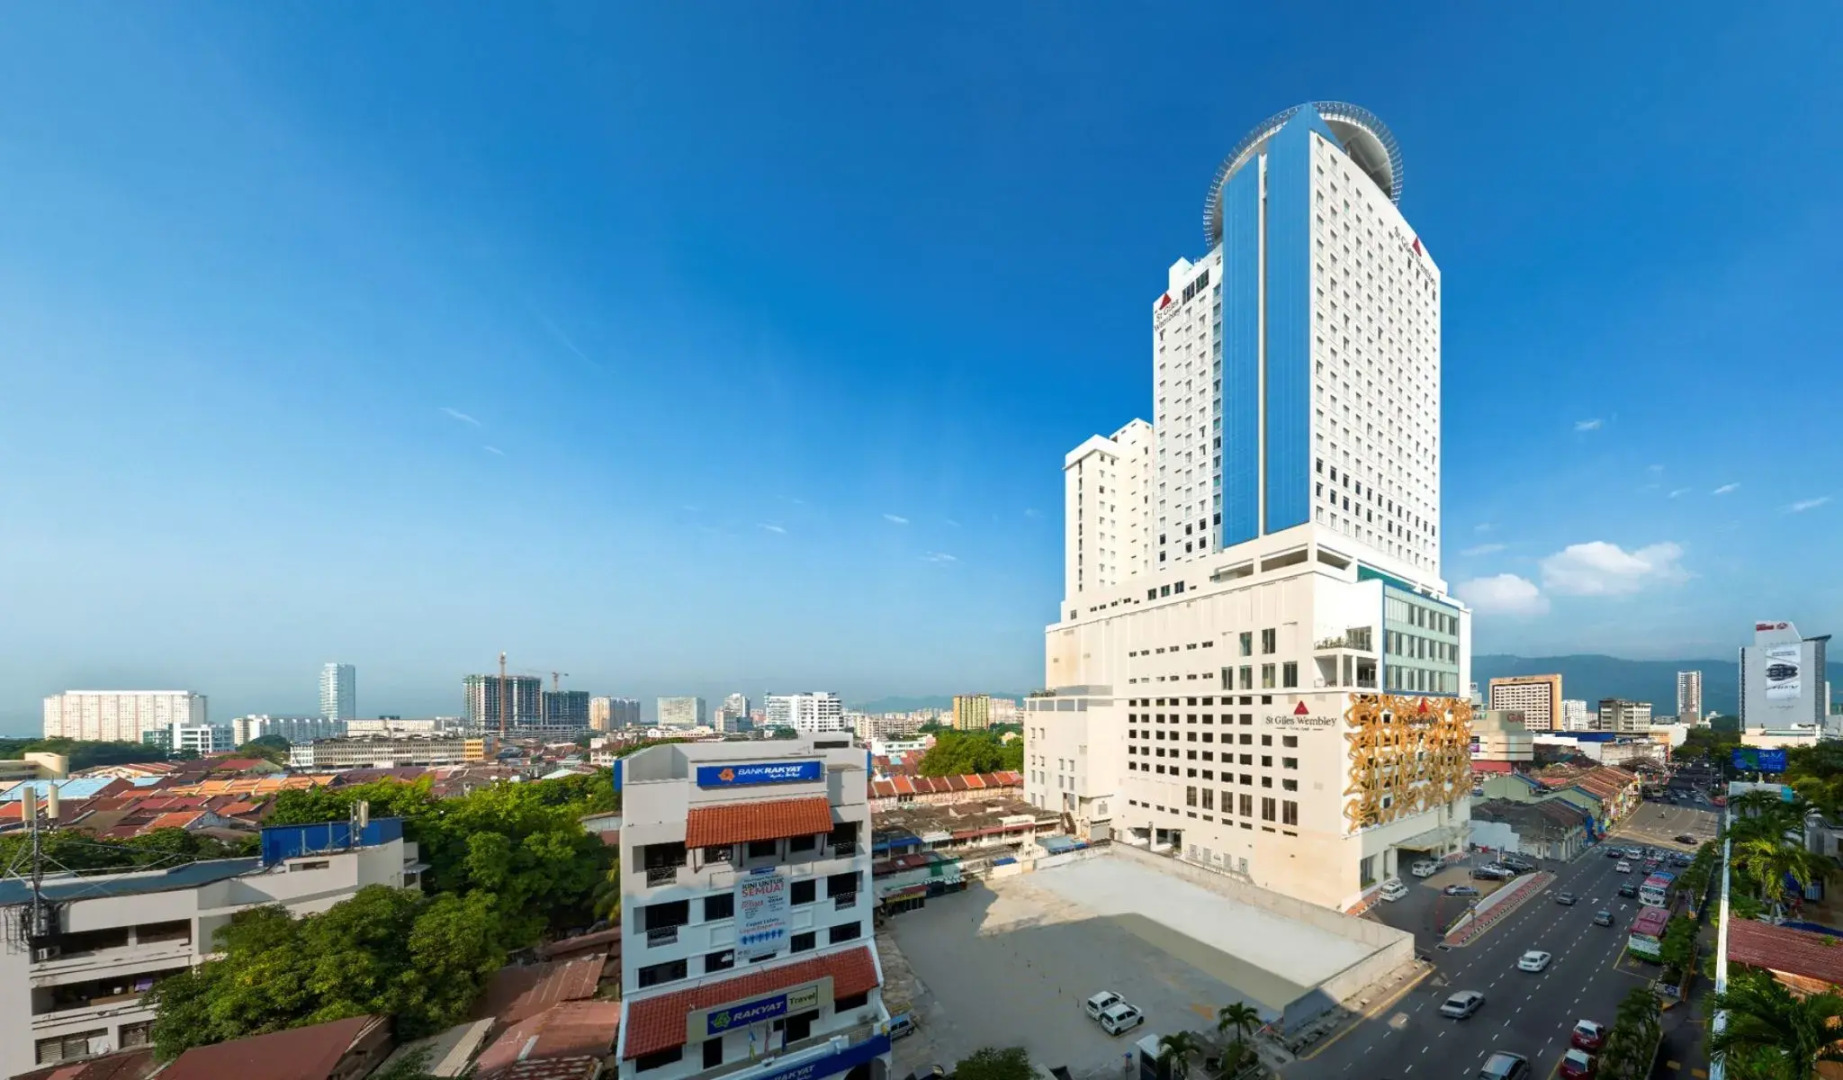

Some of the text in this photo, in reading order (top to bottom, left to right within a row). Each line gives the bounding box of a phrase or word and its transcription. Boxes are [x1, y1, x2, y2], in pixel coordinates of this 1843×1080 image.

[1265, 715, 1338, 727] St Giles Wembley
[738, 767, 764, 776] BANK
[764, 765, 803, 774] RAKYAT
[789, 992, 816, 1005] Travel
[733, 1000, 784, 1021] RAKYAT
